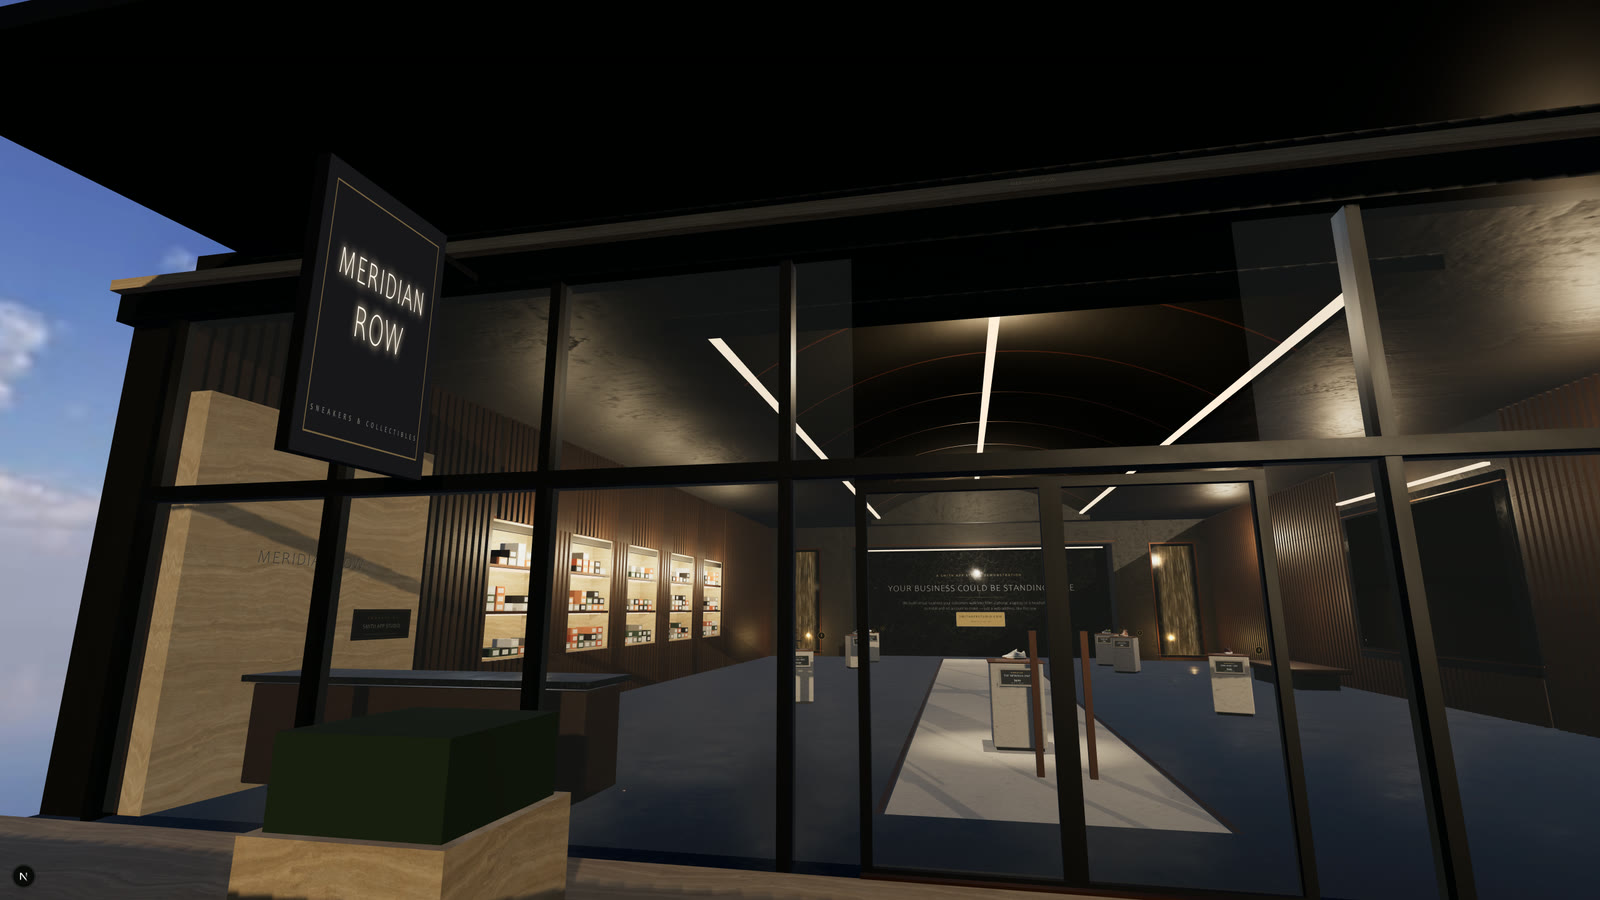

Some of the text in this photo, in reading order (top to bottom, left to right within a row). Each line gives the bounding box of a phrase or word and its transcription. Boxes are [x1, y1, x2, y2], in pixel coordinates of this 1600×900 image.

[338, 246, 425, 316] MERIDIAN
[353, 305, 404, 355] ROW
[309, 402, 417, 442] SNEAKERS & COLLECTIBLES
[257, 550, 317, 568] MERIDI
[887, 584, 912, 593] YOUR
[914, 584, 956, 593] BUSINESS
[957, 584, 988, 593] COULD
[990, 584, 1001, 592] BE
